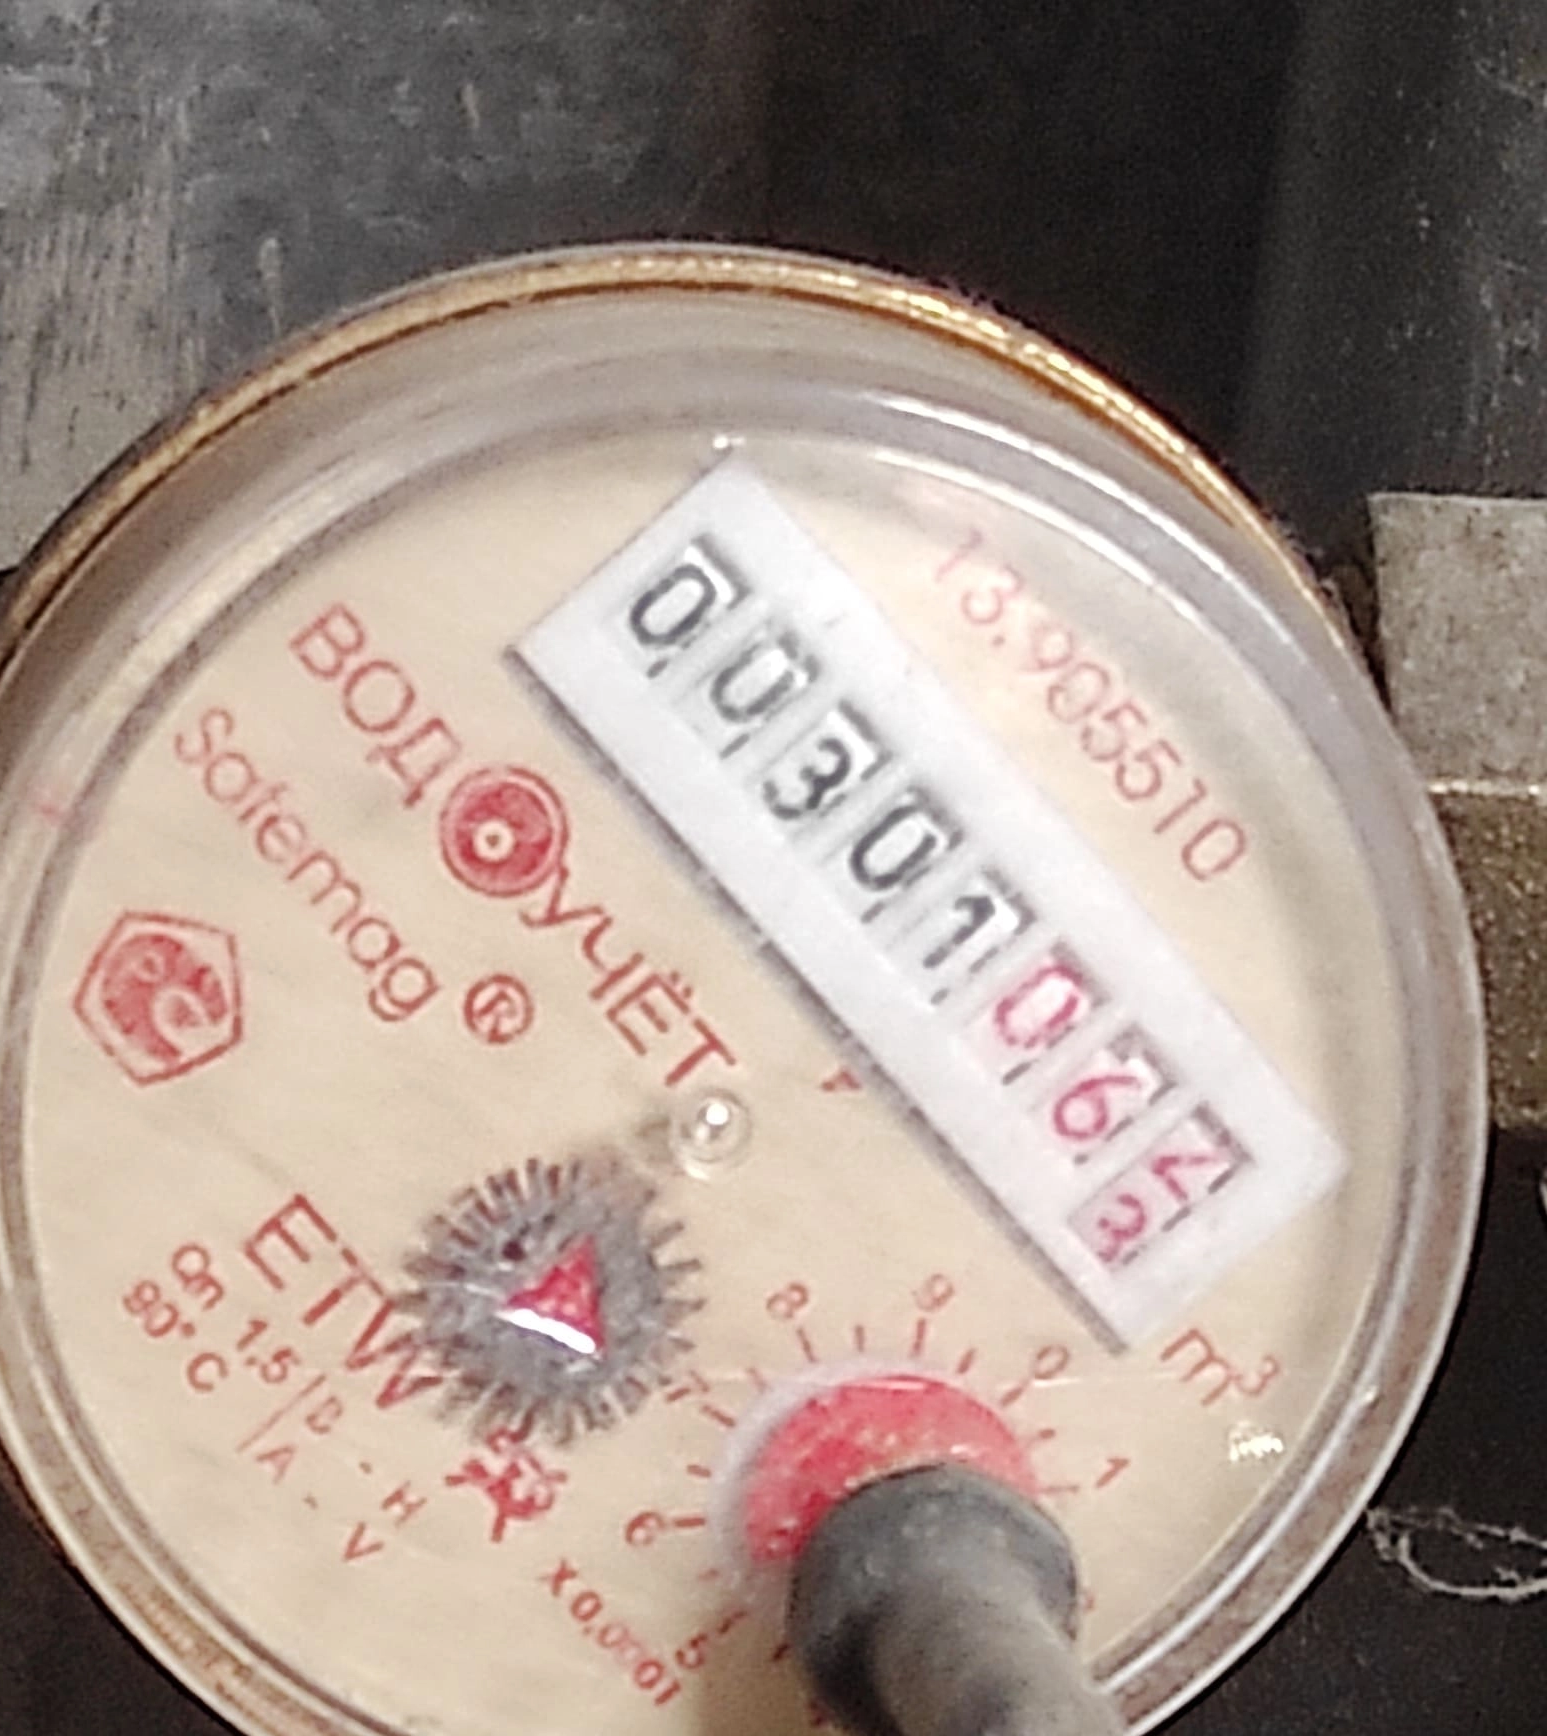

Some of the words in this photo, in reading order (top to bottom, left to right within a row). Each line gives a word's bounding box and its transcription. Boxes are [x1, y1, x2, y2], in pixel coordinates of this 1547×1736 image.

[938, 528, 1248, 881] 13.905510
[765, 1281, 810, 1321] 8
[912, 1272, 955, 1311] 9
[1032, 1345, 1070, 1380] 0
[1095, 1456, 1130, 1489] 1
[625, 1510, 670, 1546] 6
